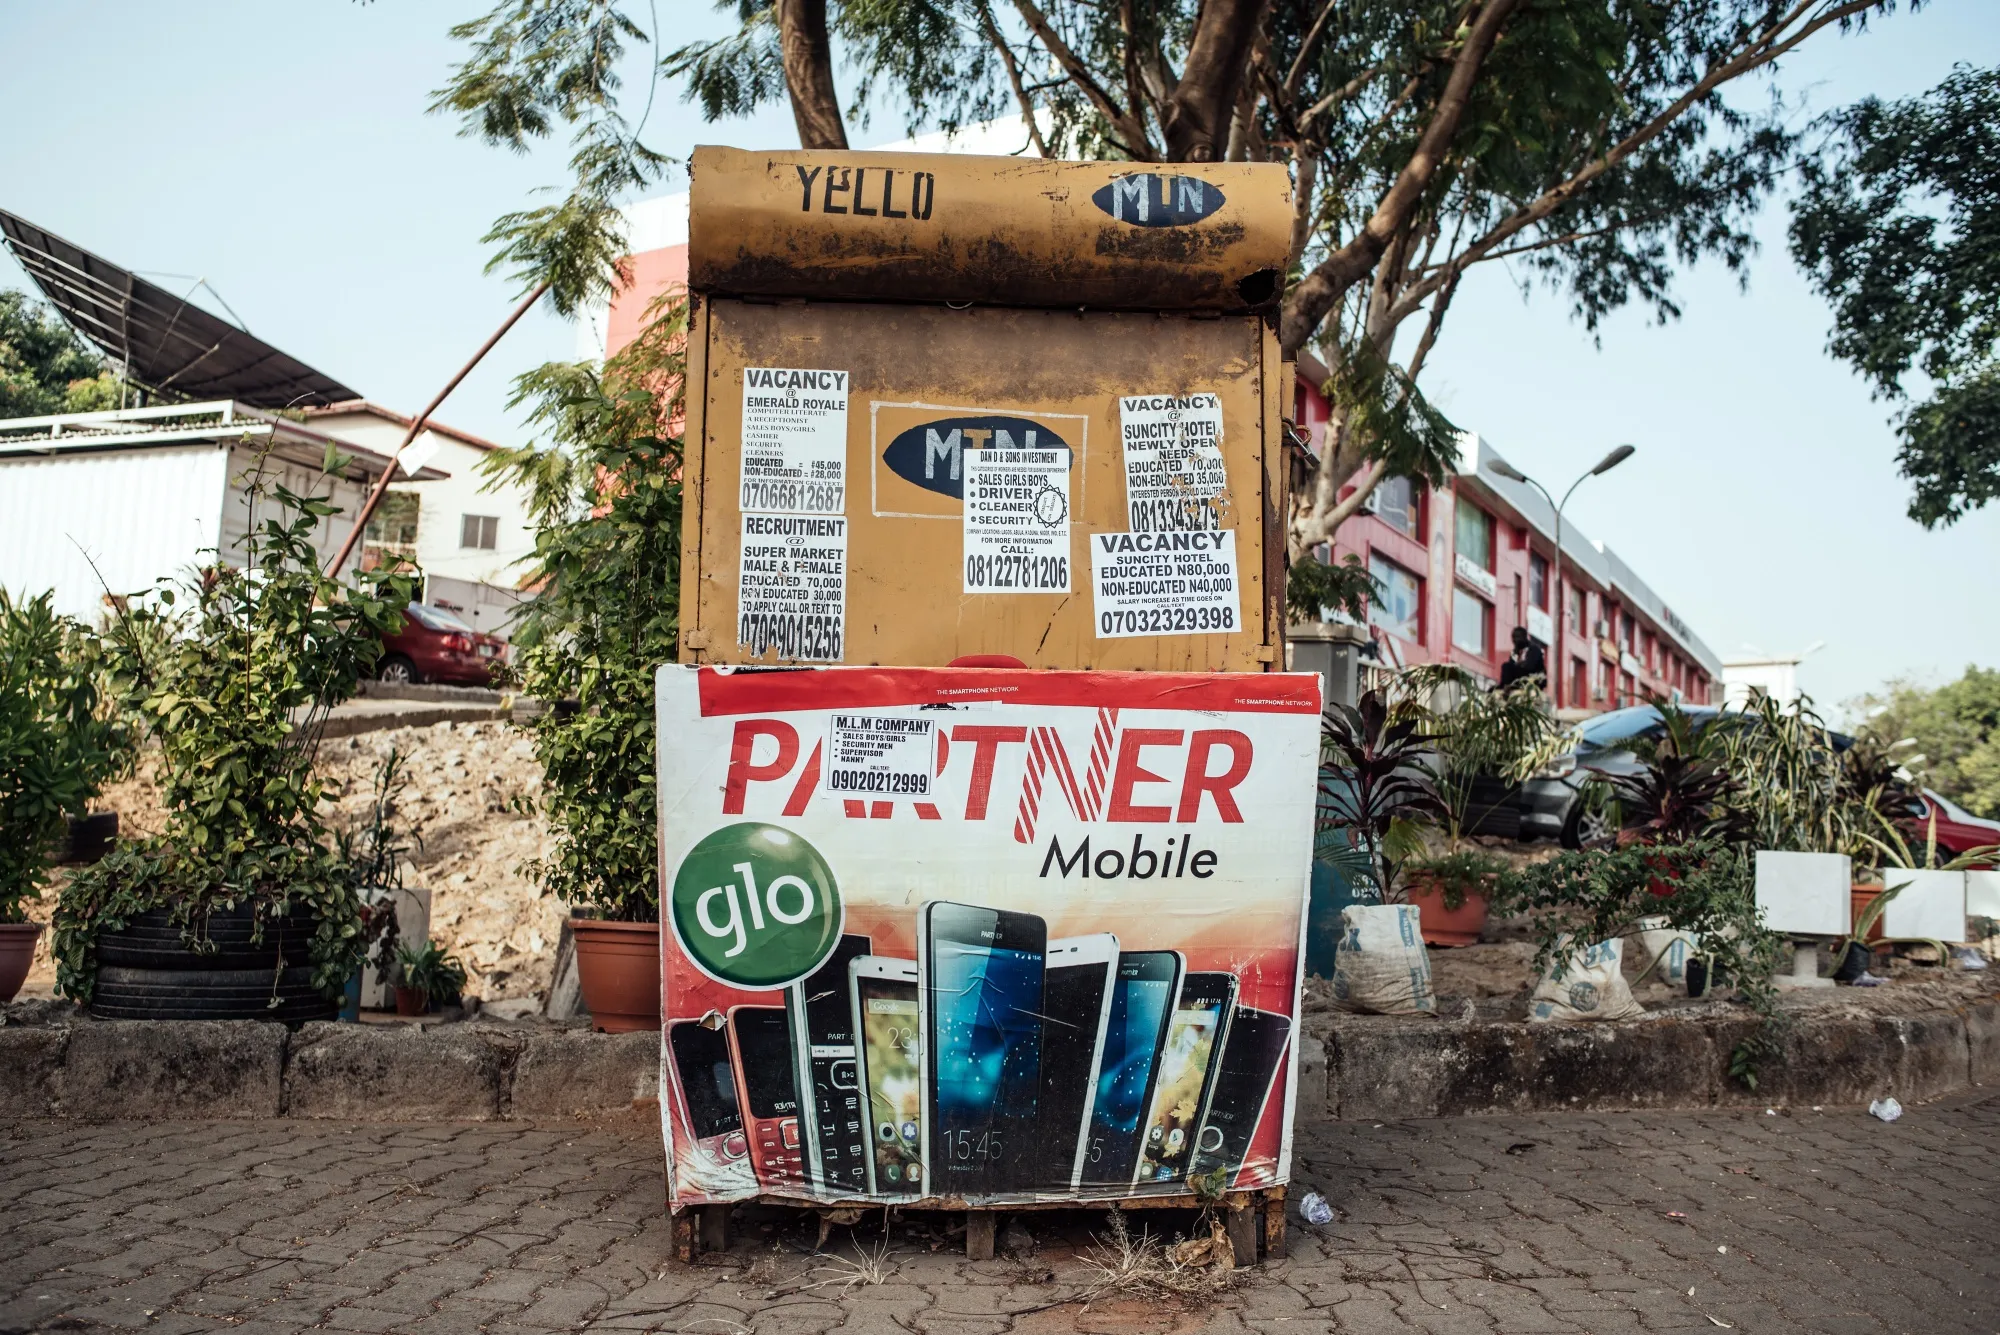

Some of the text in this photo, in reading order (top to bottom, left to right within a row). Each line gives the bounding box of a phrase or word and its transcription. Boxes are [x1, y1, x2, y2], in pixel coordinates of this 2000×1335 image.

[796, 166, 934, 220] YELLO
[1112, 174, 1204, 221] MTN
[747, 370, 846, 390] VACANCY
[786, 389, 796, 398] @
[748, 397, 845, 410] EMERALD ROYALE
[1124, 396, 1216, 411] VACANCY
[754, 416, 808, 424] RECEPTIONIST
[1125, 423, 1177, 439] SUNCITY
[1128, 438, 1218, 451] NEWLY OPEN
[980, 451, 992, 462] DAN
[994, 451, 998, 462] D
[1006, 452, 1020, 463] SONS
[1022, 452, 1057, 464] INVESTMENT
[1159, 449, 1195, 459] NEEDS
[746, 458, 784, 468] EDUCATED
[1129, 460, 1182, 473] EDUCATED
[744, 467, 802, 478] NON-EDUCATED
[1197, 471, 1224, 486] 35,000
[979, 474, 1002, 486] SALES
[742, 483, 844, 511] 07066812687
[979, 488, 1033, 499] DRIVER
[1130, 490, 1159, 499] INTERESTED
[1160, 488, 1179, 498] PERSON
[979, 502, 1032, 512] CLEANER
[746, 518, 844, 537] RECRUITMENT
[979, 516, 1033, 525] SECURITY
[786, 537, 804, 546] @
[1100, 532, 1226, 553] VACANCY
[744, 546, 843, 560] SUPER MARKET
[1001, 546, 1034, 554] CALL:
[1117, 554, 1213, 564] SUNCITY HOTEL
[744, 560, 842, 574] MALE & FEMALE
[967, 555, 1067, 588] 08122781206
[1101, 563, 1230, 578] EDUCATED N80,000
[742, 575, 842, 590] EDUCATED 70,000
[1101, 578, 1232, 596] NON-EDUCATED N40,000
[763, 588, 808, 600] EDUCATED
[814, 590, 841, 602] 30,000
[742, 601, 841, 614] TO APPLY CALL OR TEXT TO
[1101, 607, 1234, 634] 07032329398
[740, 613, 840, 659] 07069015256
[837, 717, 871, 729] M.L.M
[876, 719, 930, 732] COMPANY
[843, 733, 865, 741] SALES
[842, 741, 875, 749] SECURITY
[841, 749, 883, 757] SUPERVISOR
[832, 770, 927, 794] 09020212999
[1040, 834, 1218, 879] Mobile
[696, 862, 815, 957] glo
[943, 1130, 1002, 1160] 15:45
